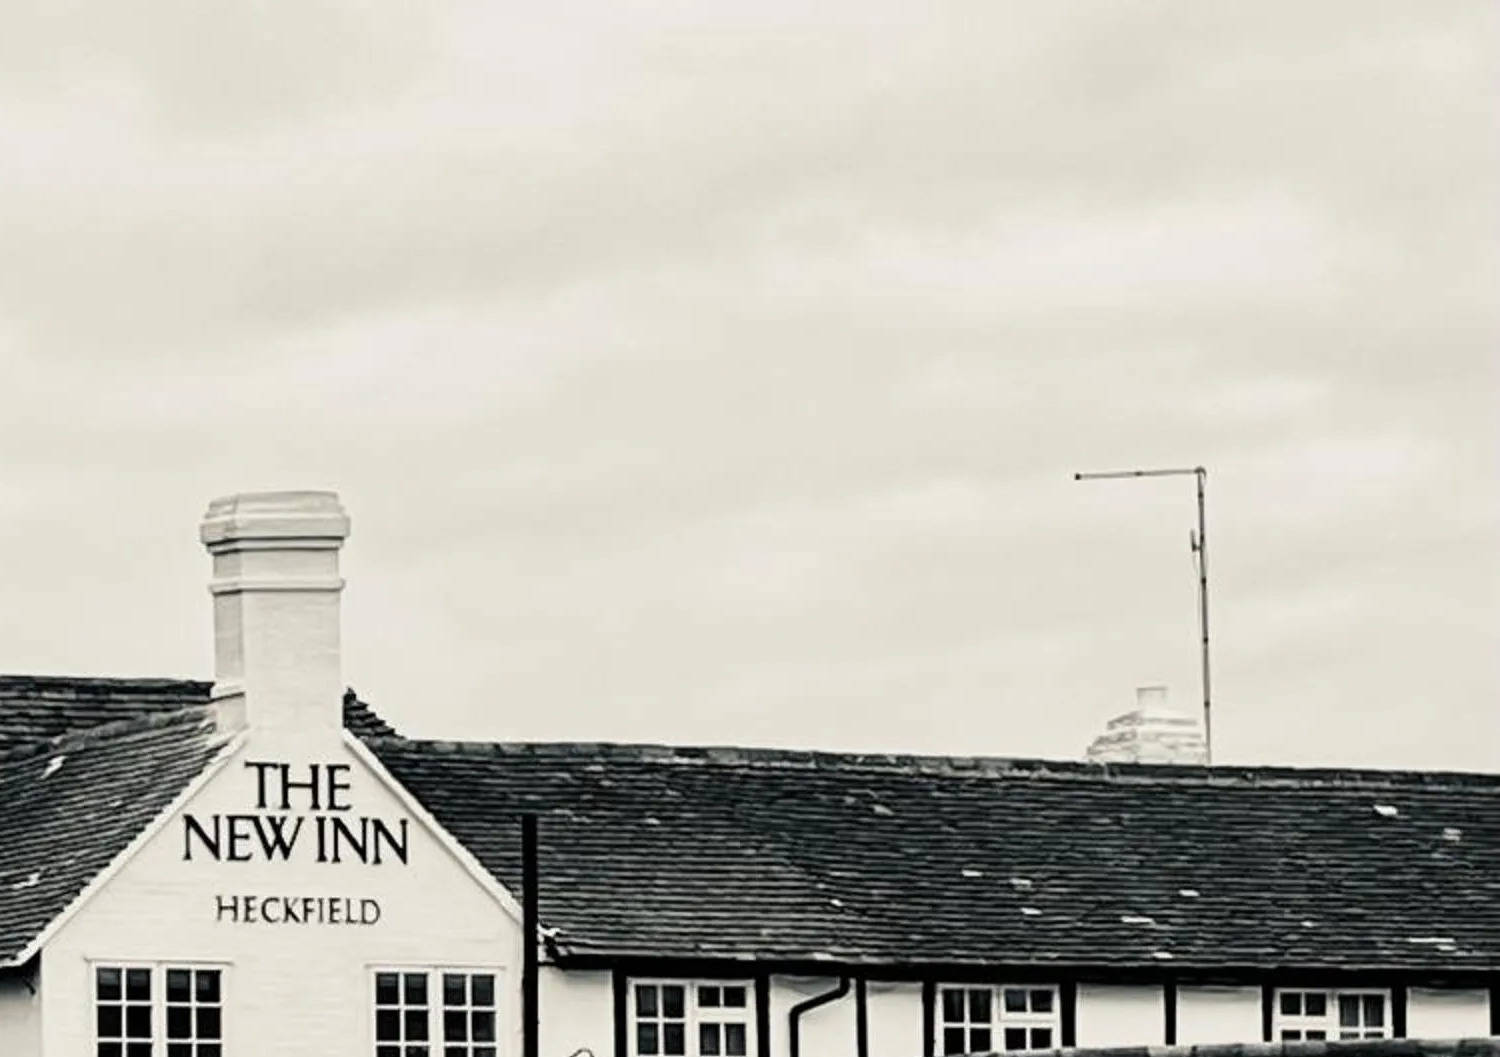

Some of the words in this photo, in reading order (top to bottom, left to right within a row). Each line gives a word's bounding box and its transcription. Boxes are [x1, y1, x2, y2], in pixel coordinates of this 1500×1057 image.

[244, 761, 352, 812] THE
[182, 813, 305, 862] NEW
[315, 815, 408, 866] INN
[215, 895, 381, 925] HECKFIELD
